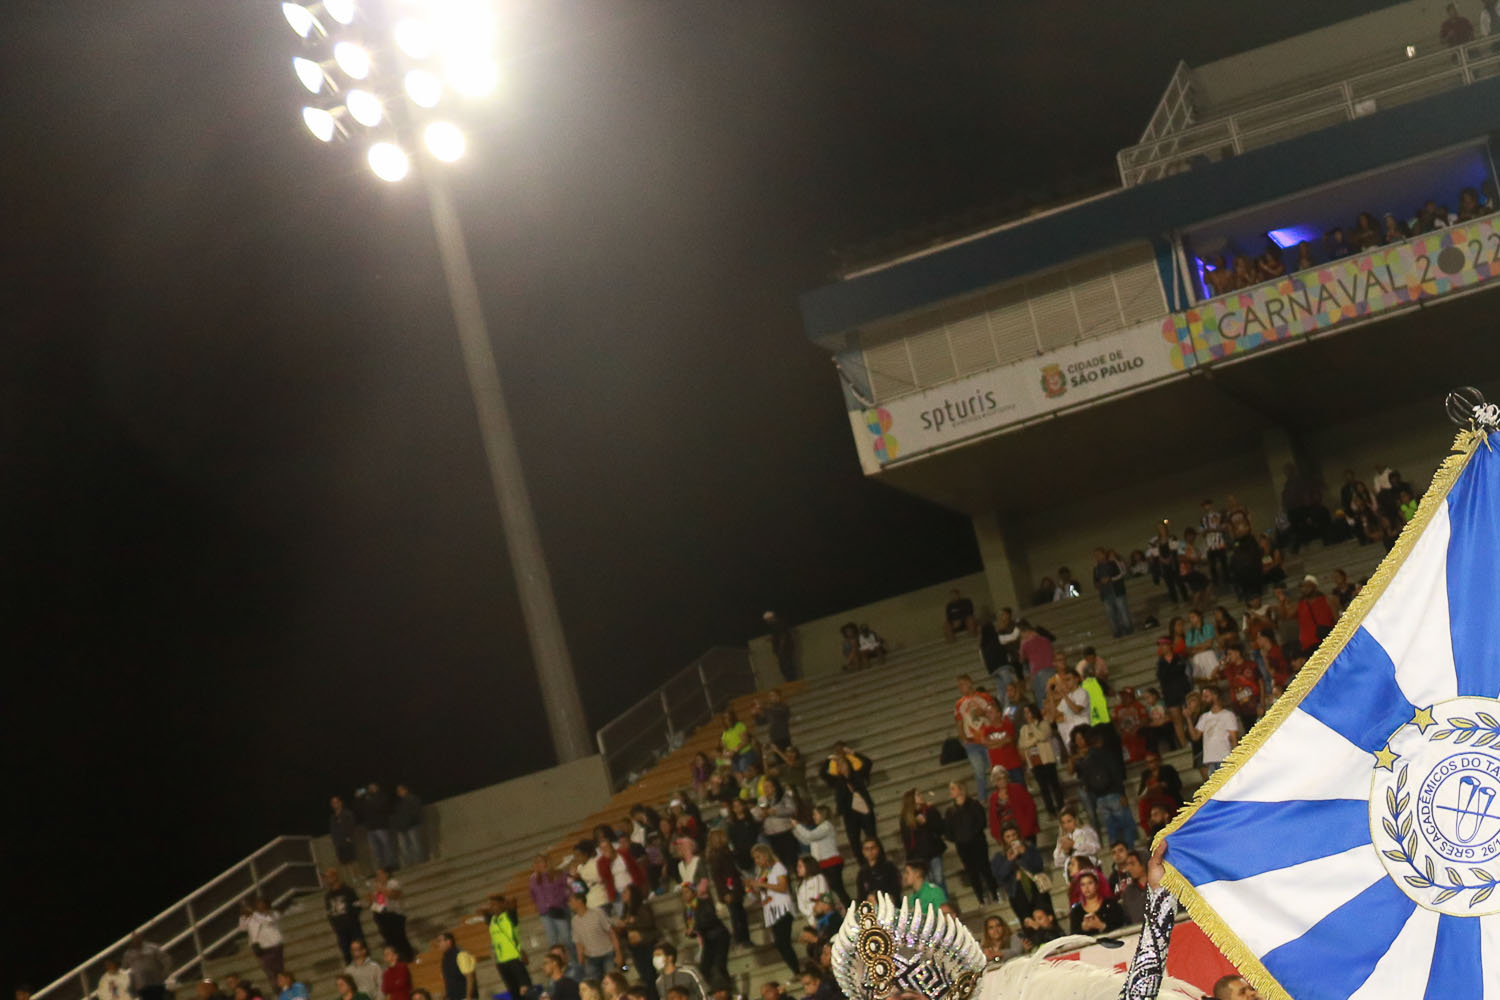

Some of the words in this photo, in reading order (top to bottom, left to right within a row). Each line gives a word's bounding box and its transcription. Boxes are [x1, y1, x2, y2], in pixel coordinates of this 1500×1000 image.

[1217, 263, 1408, 340] CARNAVAL
[1067, 355, 1106, 374] CIDADE
[1109, 350, 1123, 361] DE
[1070, 371, 1098, 388] SÃO
[1101, 356, 1144, 379] PAULO
[920, 389, 996, 432] spturis
[1440, 841, 1475, 858] GRES
[1461, 758, 1481, 767] DO
